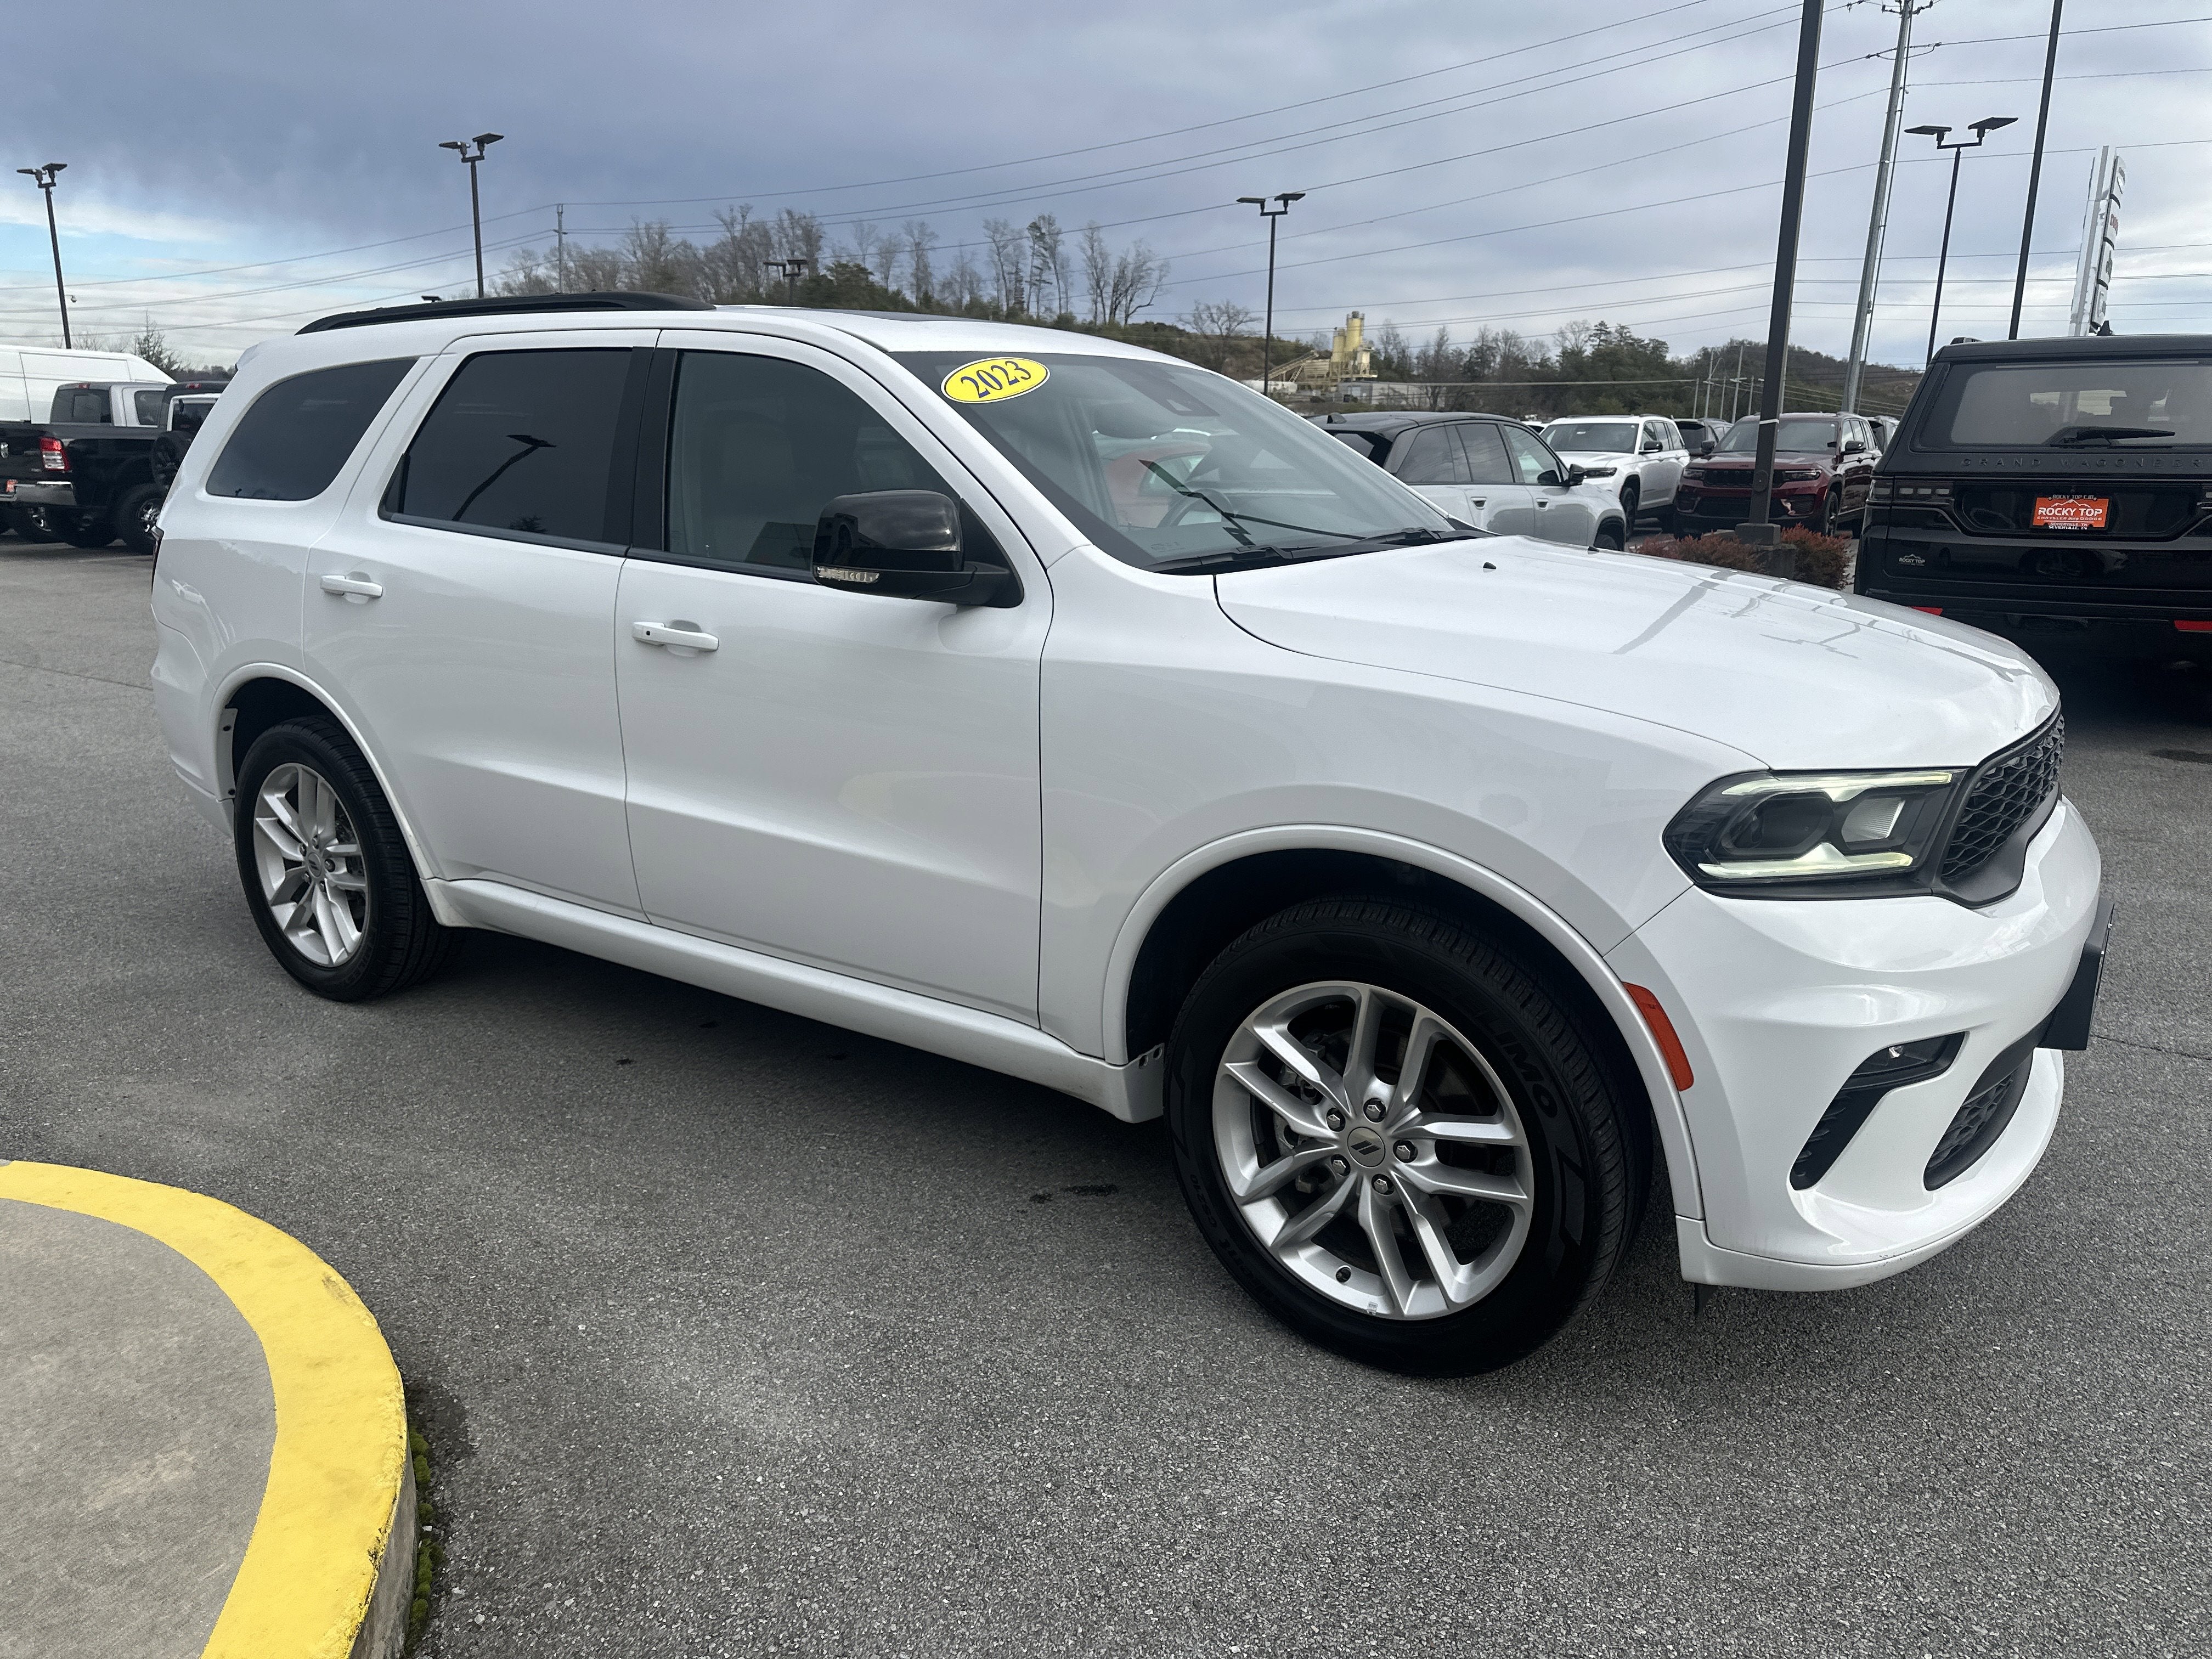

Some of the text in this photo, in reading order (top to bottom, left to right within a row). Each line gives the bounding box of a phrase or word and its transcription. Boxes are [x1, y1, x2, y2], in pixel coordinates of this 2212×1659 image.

[960, 360, 1031, 399] 2023
[1961, 458, 2203, 467] GRAND WAGONEER
[2038, 507, 2103, 517] ROCKY TOP
